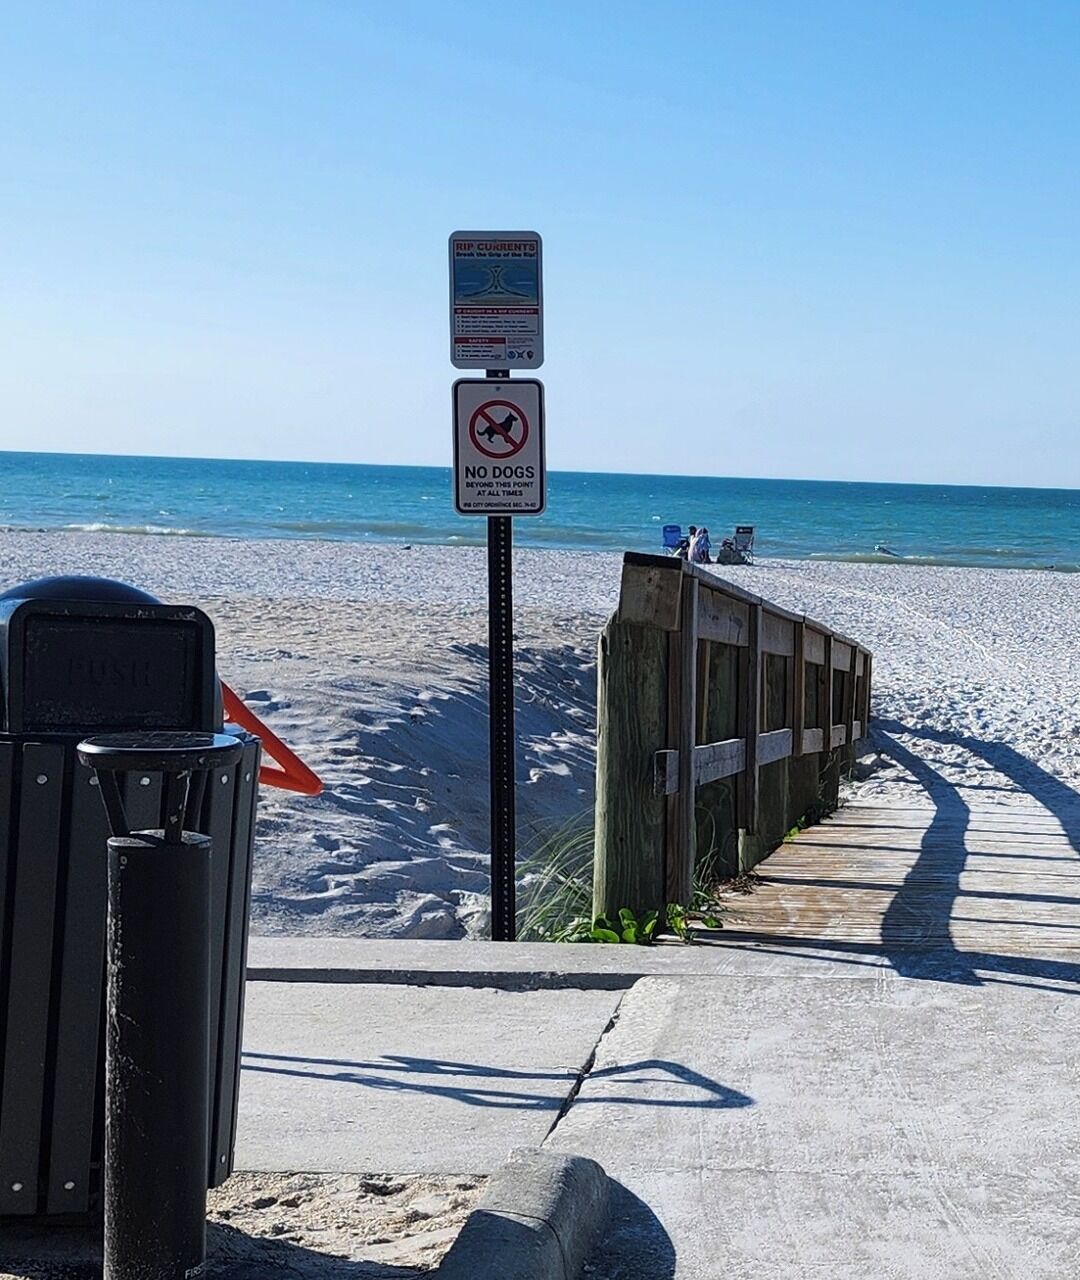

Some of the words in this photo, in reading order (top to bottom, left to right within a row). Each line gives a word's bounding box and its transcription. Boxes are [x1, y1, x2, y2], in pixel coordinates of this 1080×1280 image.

[456, 243, 475, 251] RIP
[477, 243, 536, 251] CURRENTS
[465, 466, 488, 479] NO
[492, 466, 535, 479] DOGS
